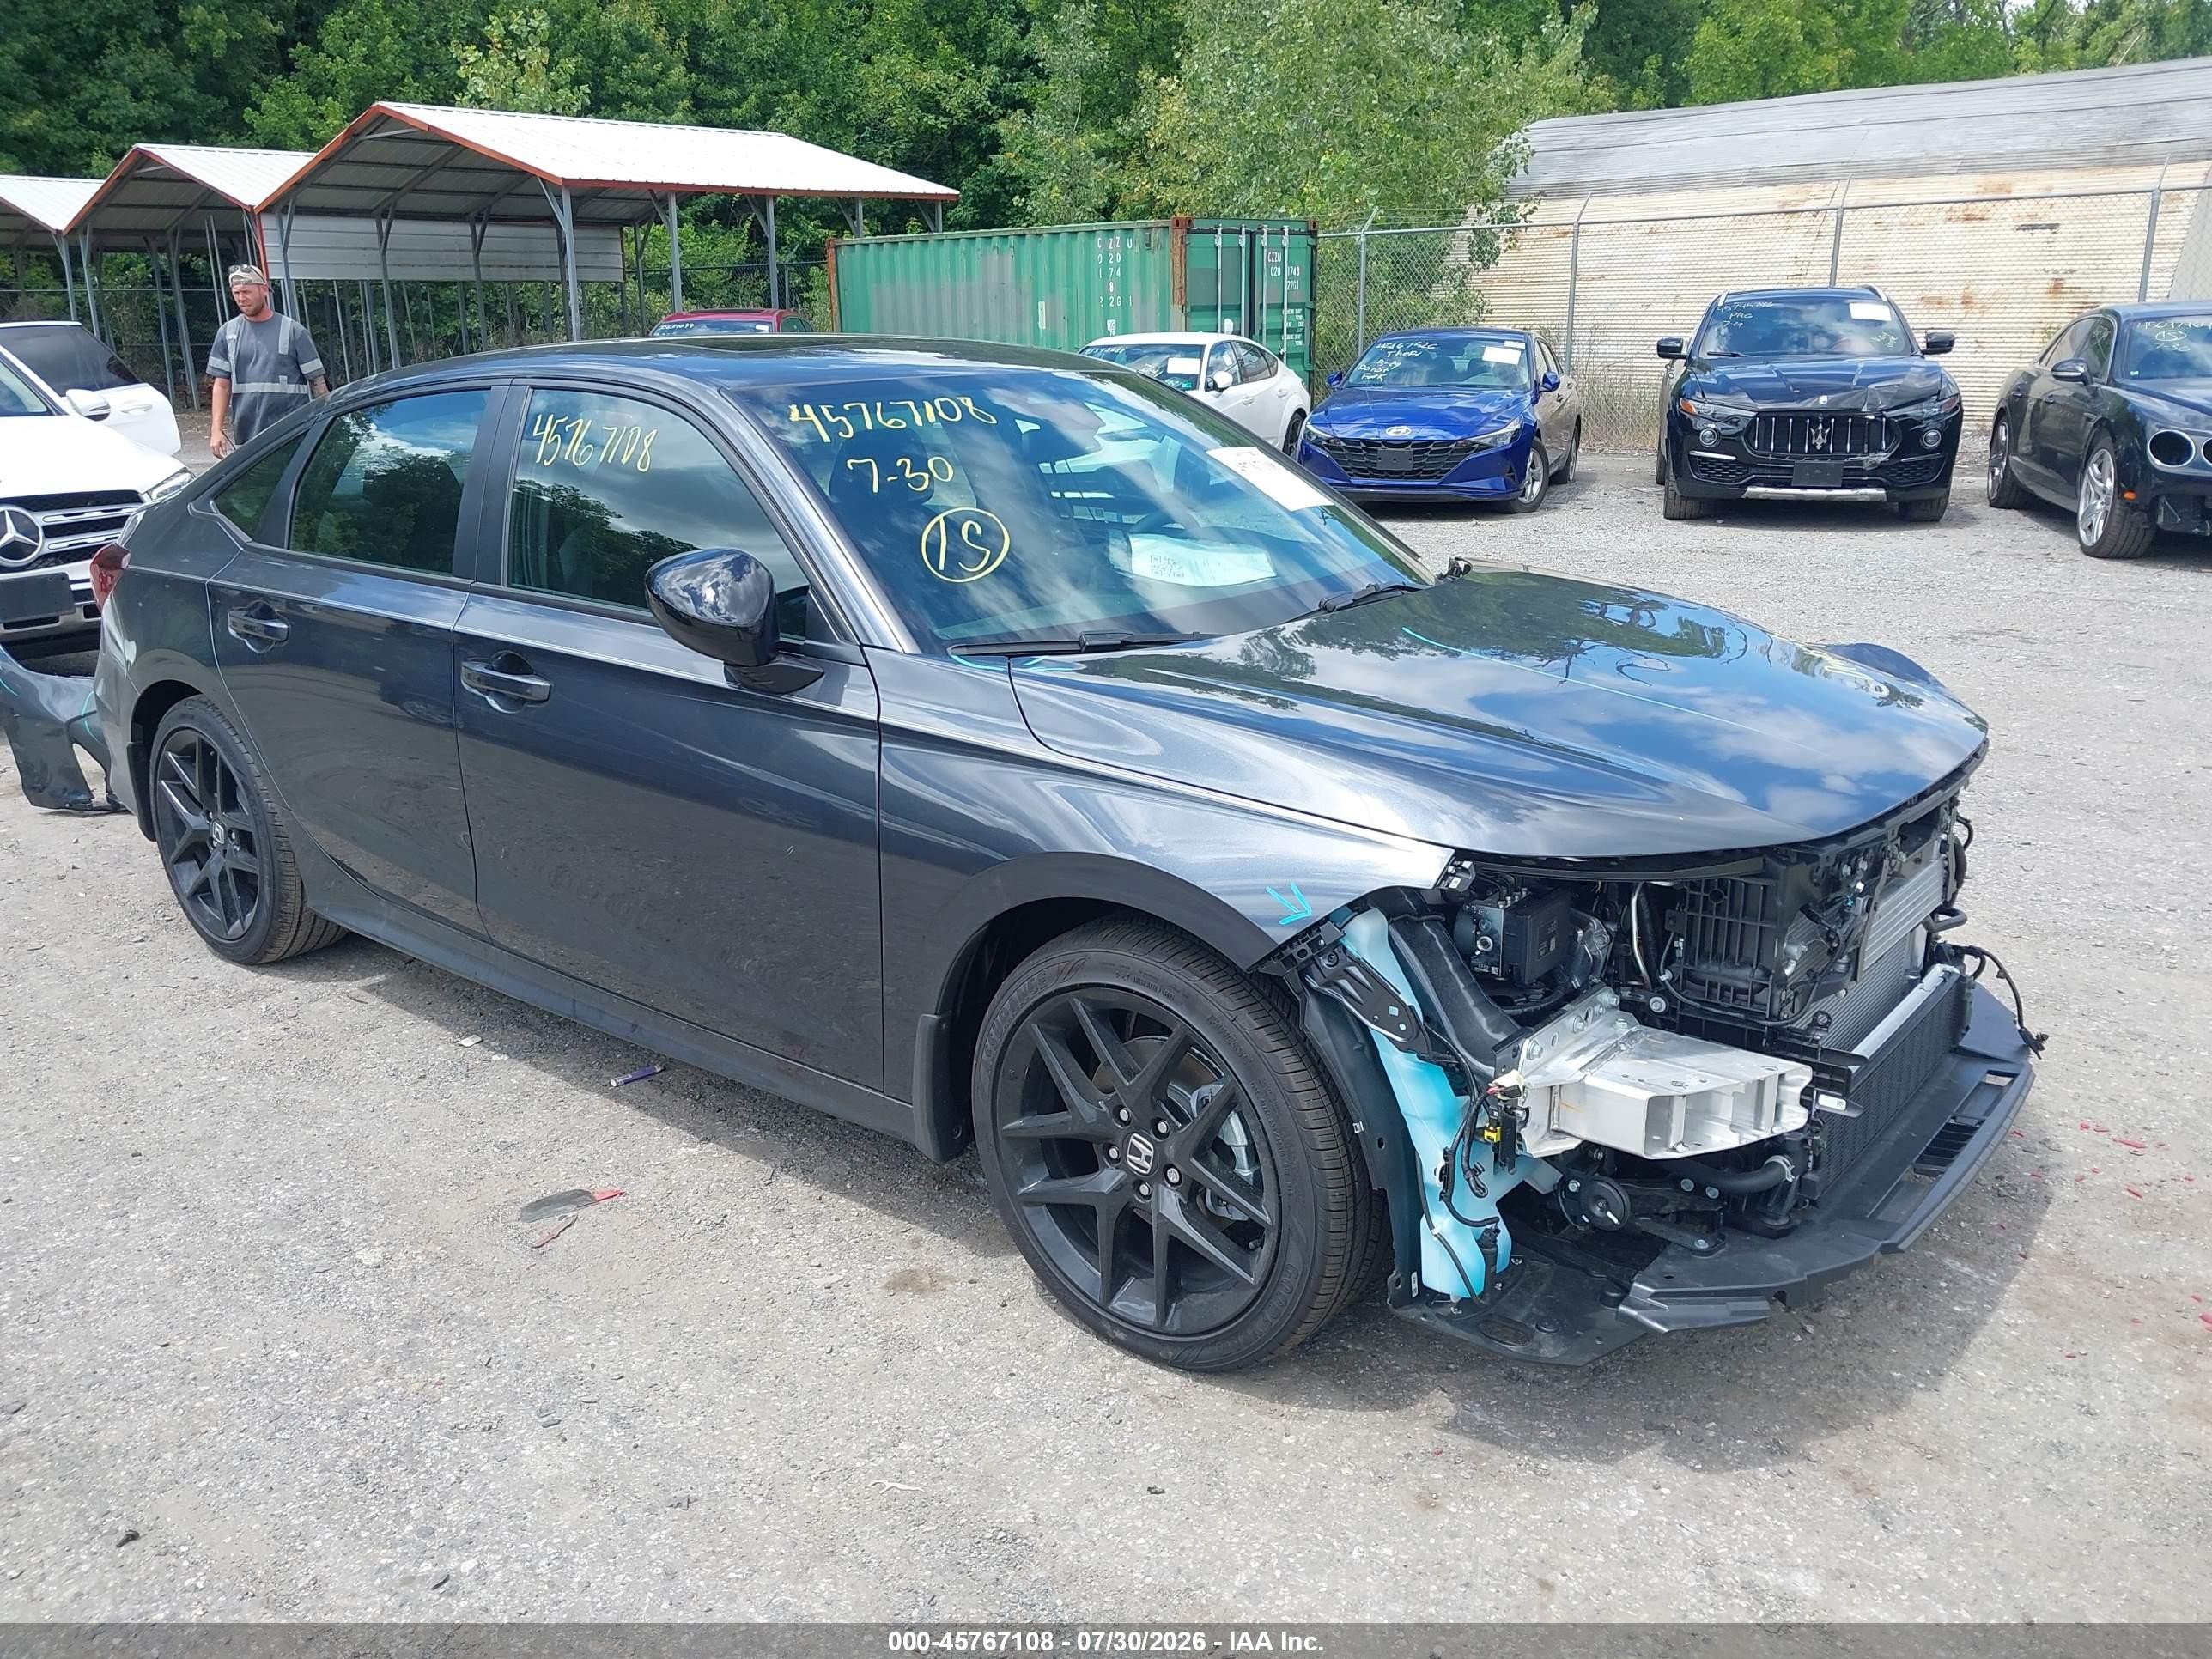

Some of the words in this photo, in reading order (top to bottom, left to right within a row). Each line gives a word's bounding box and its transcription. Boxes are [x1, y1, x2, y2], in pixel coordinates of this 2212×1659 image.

[1267, 252, 1281, 263] CZZU
[788, 395, 998, 443] 45767108
[846, 455, 955, 493] 7-30
